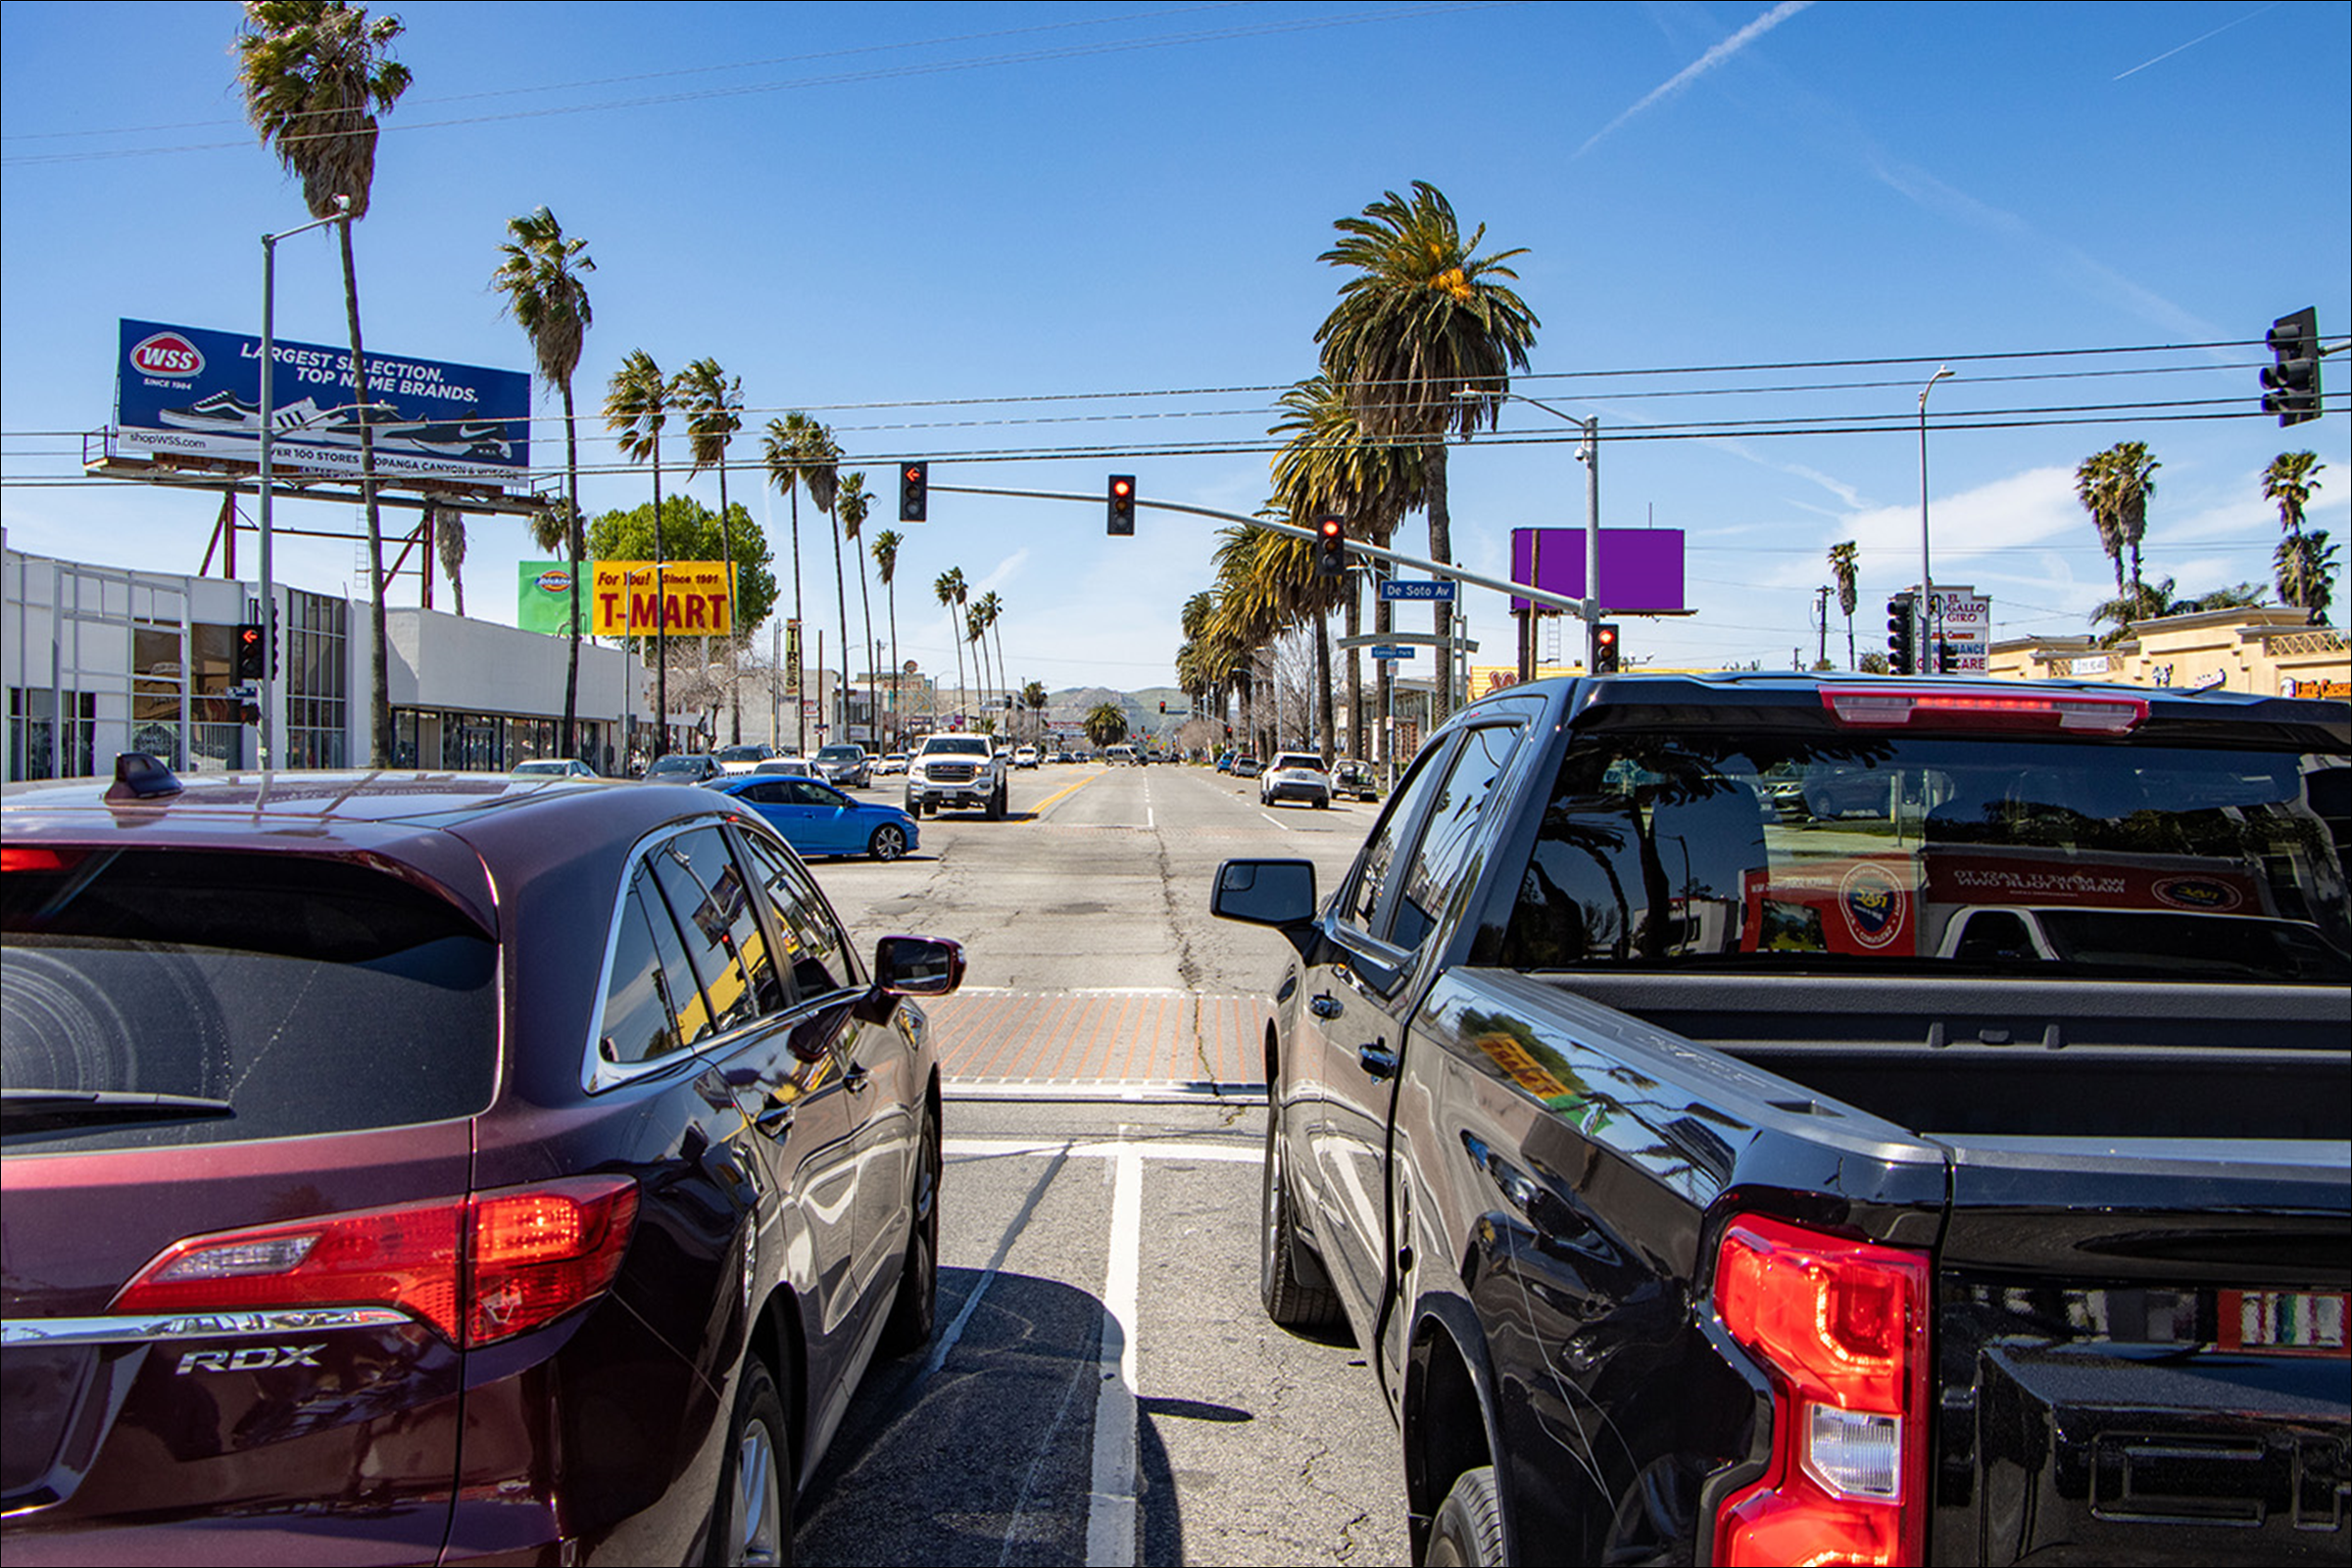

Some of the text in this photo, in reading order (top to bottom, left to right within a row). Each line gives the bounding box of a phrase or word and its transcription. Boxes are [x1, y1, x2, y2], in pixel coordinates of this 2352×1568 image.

[141, 346, 195, 370] WSS
[240, 342, 333, 368] LARGEST
[143, 377, 171, 389] SINCE
[297, 366, 479, 404] TOP NME BRANDS.
[129, 432, 207, 449] shopWSS.com
[271, 448, 292, 459] VER
[294, 448, 314, 461] 100
[316, 451, 360, 465] STORES
[373, 455, 419, 470] OPANGA
[598, 571, 651, 586] For You!
[662, 574, 718, 585] Since 1991
[1387, 584, 1449, 596] De Soto Av
[1947, 593, 1961, 604] EL
[599, 592, 727, 628] T-MART
[1946, 603, 1986, 613] GALLO
[1946, 612, 1978, 623] GIRO
[786, 627, 798, 687] TIRES
[1932, 644, 1986, 656] NANCE
[174, 1343, 329, 1375] RDX
